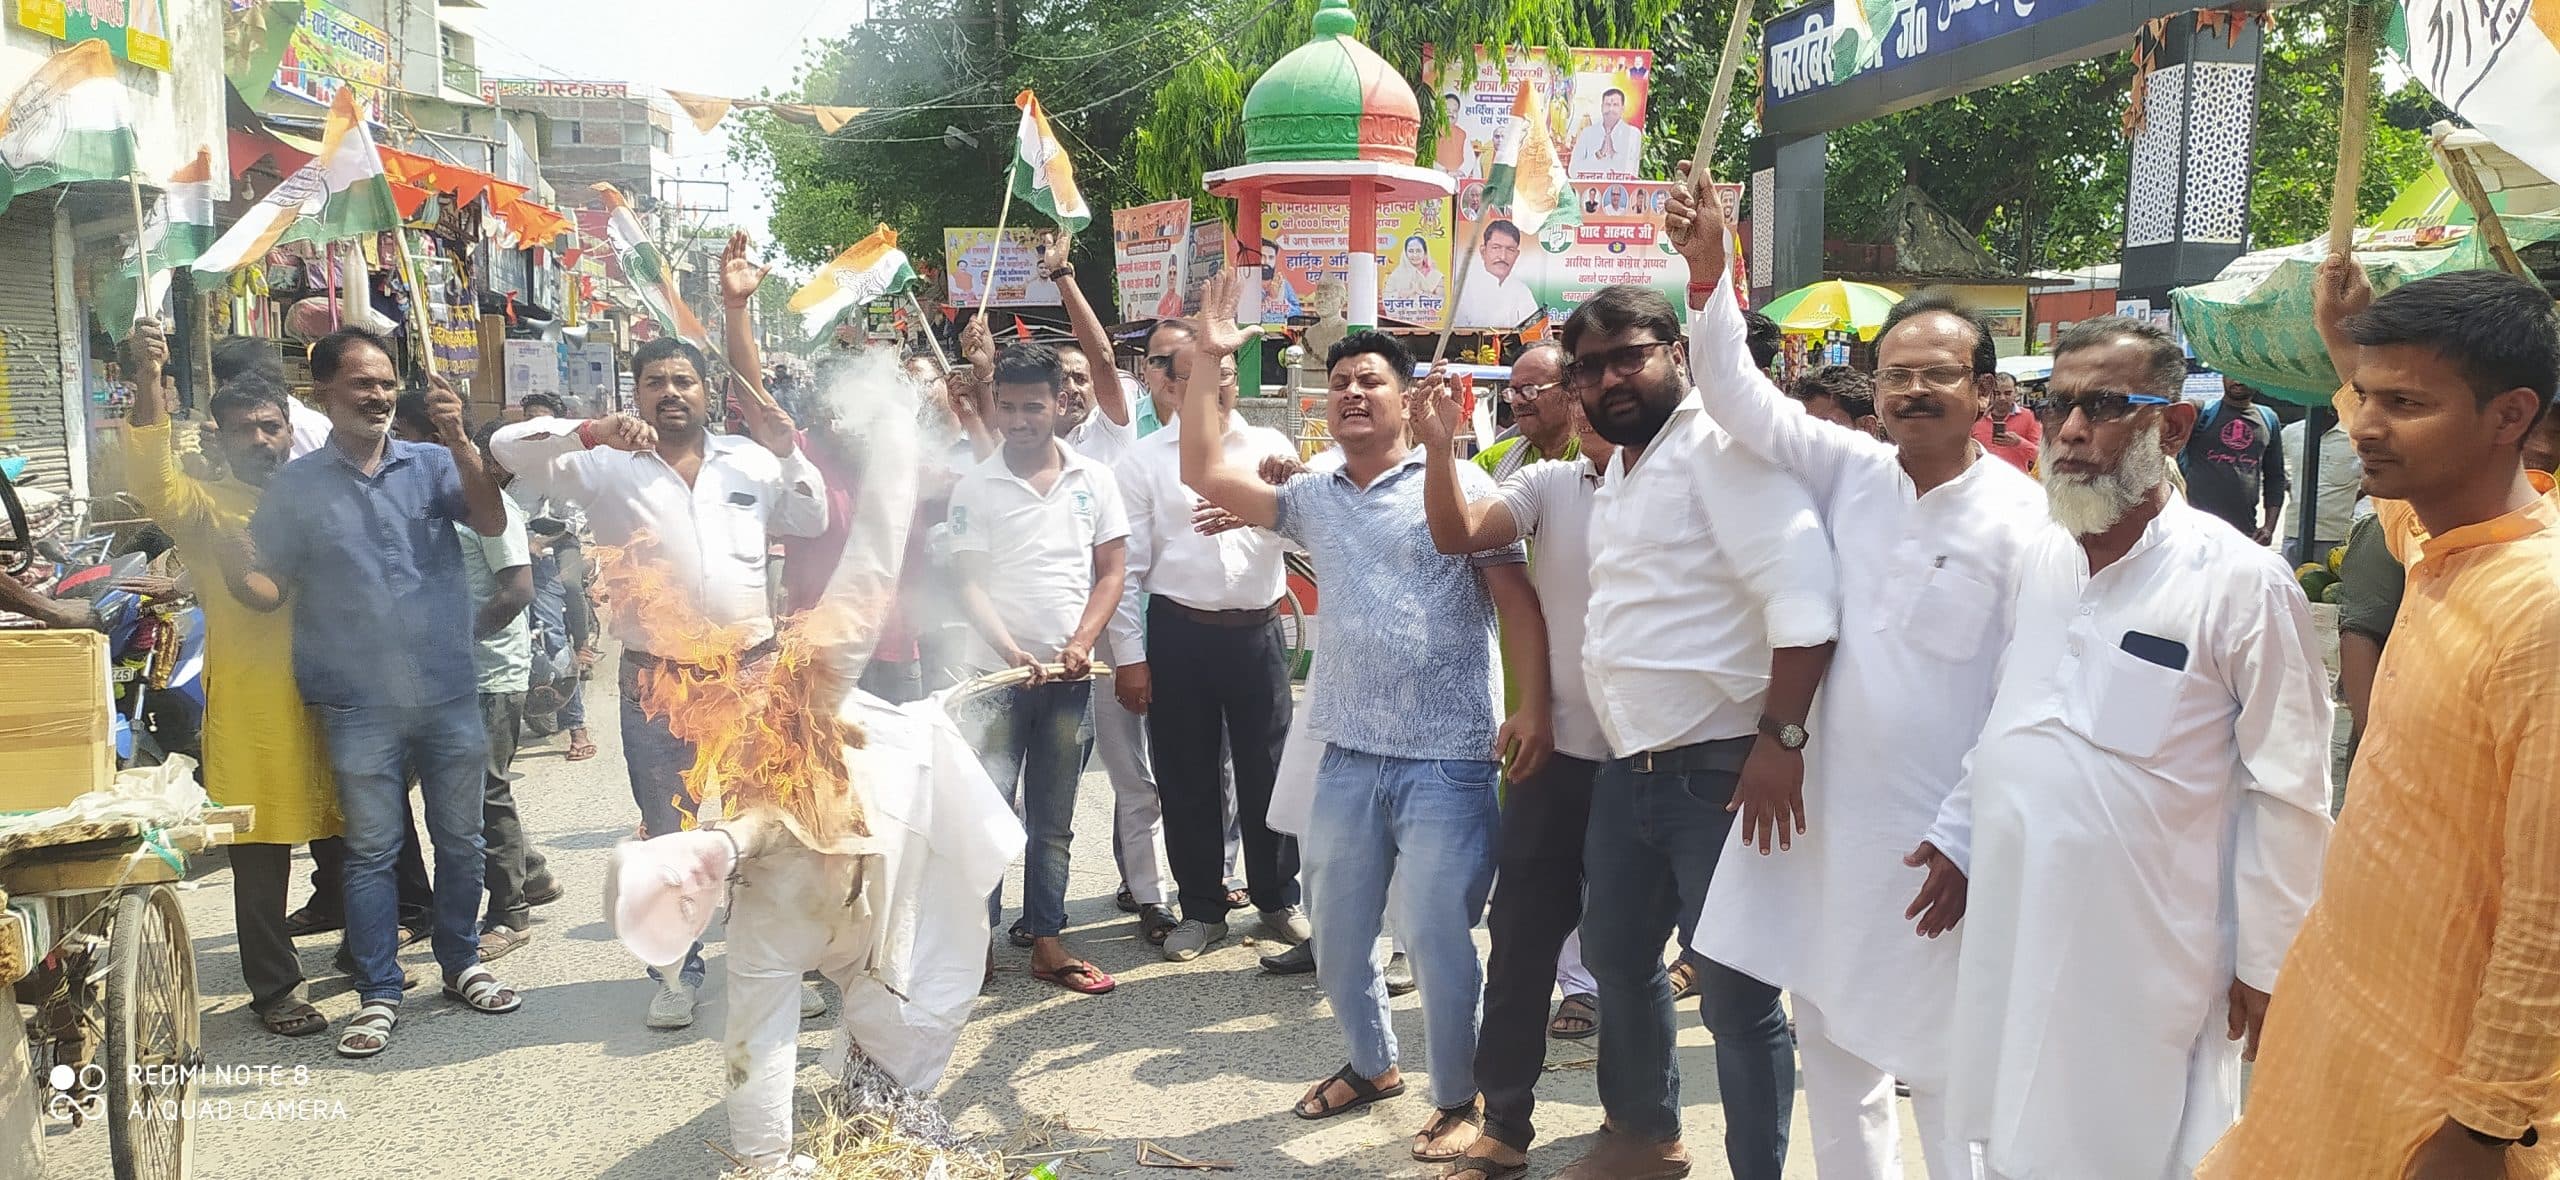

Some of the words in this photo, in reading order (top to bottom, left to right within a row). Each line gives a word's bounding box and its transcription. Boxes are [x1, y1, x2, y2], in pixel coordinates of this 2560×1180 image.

[1298, 220, 1318, 228] 1008
[1580, 224, 1600, 239] शाद
[1604, 224, 1635, 240] अहमद
[1638, 224, 1653, 240] जी
[1286, 251, 1323, 270] हार्दिक
[1594, 256, 1613, 269] जिला
[1384, 296, 1414, 312] गुंजन
[1418, 296, 1442, 310] सिंह
